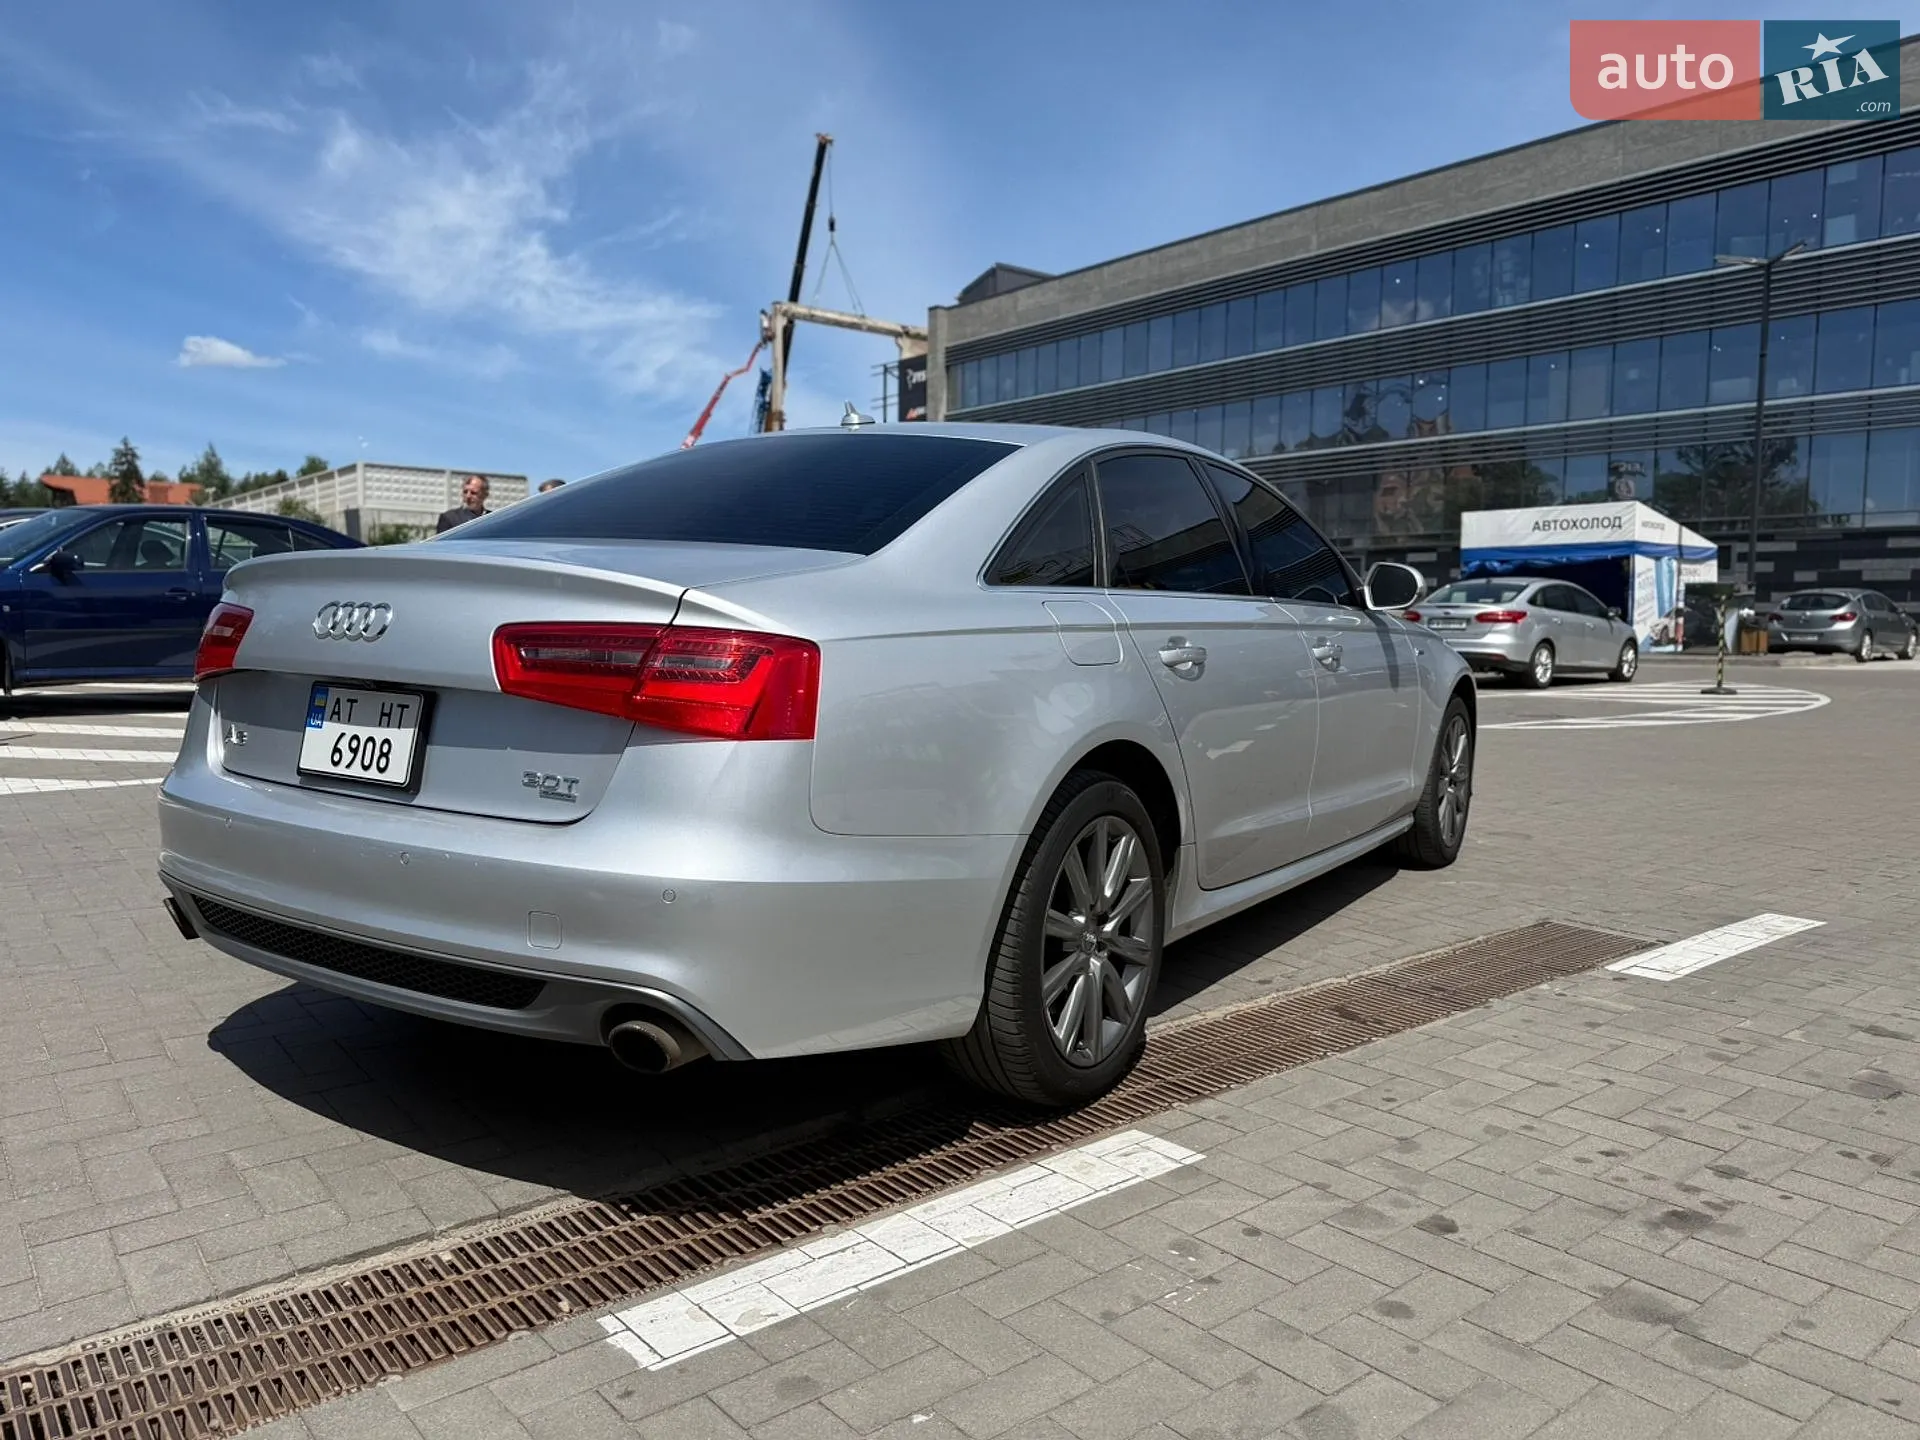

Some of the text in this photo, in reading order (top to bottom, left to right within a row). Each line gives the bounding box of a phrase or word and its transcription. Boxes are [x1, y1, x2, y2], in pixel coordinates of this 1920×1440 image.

[1532, 516, 1622, 531] АВТОХОЛОД
[330, 697, 409, 729] AT HT
[331, 732, 392, 774] 6908
